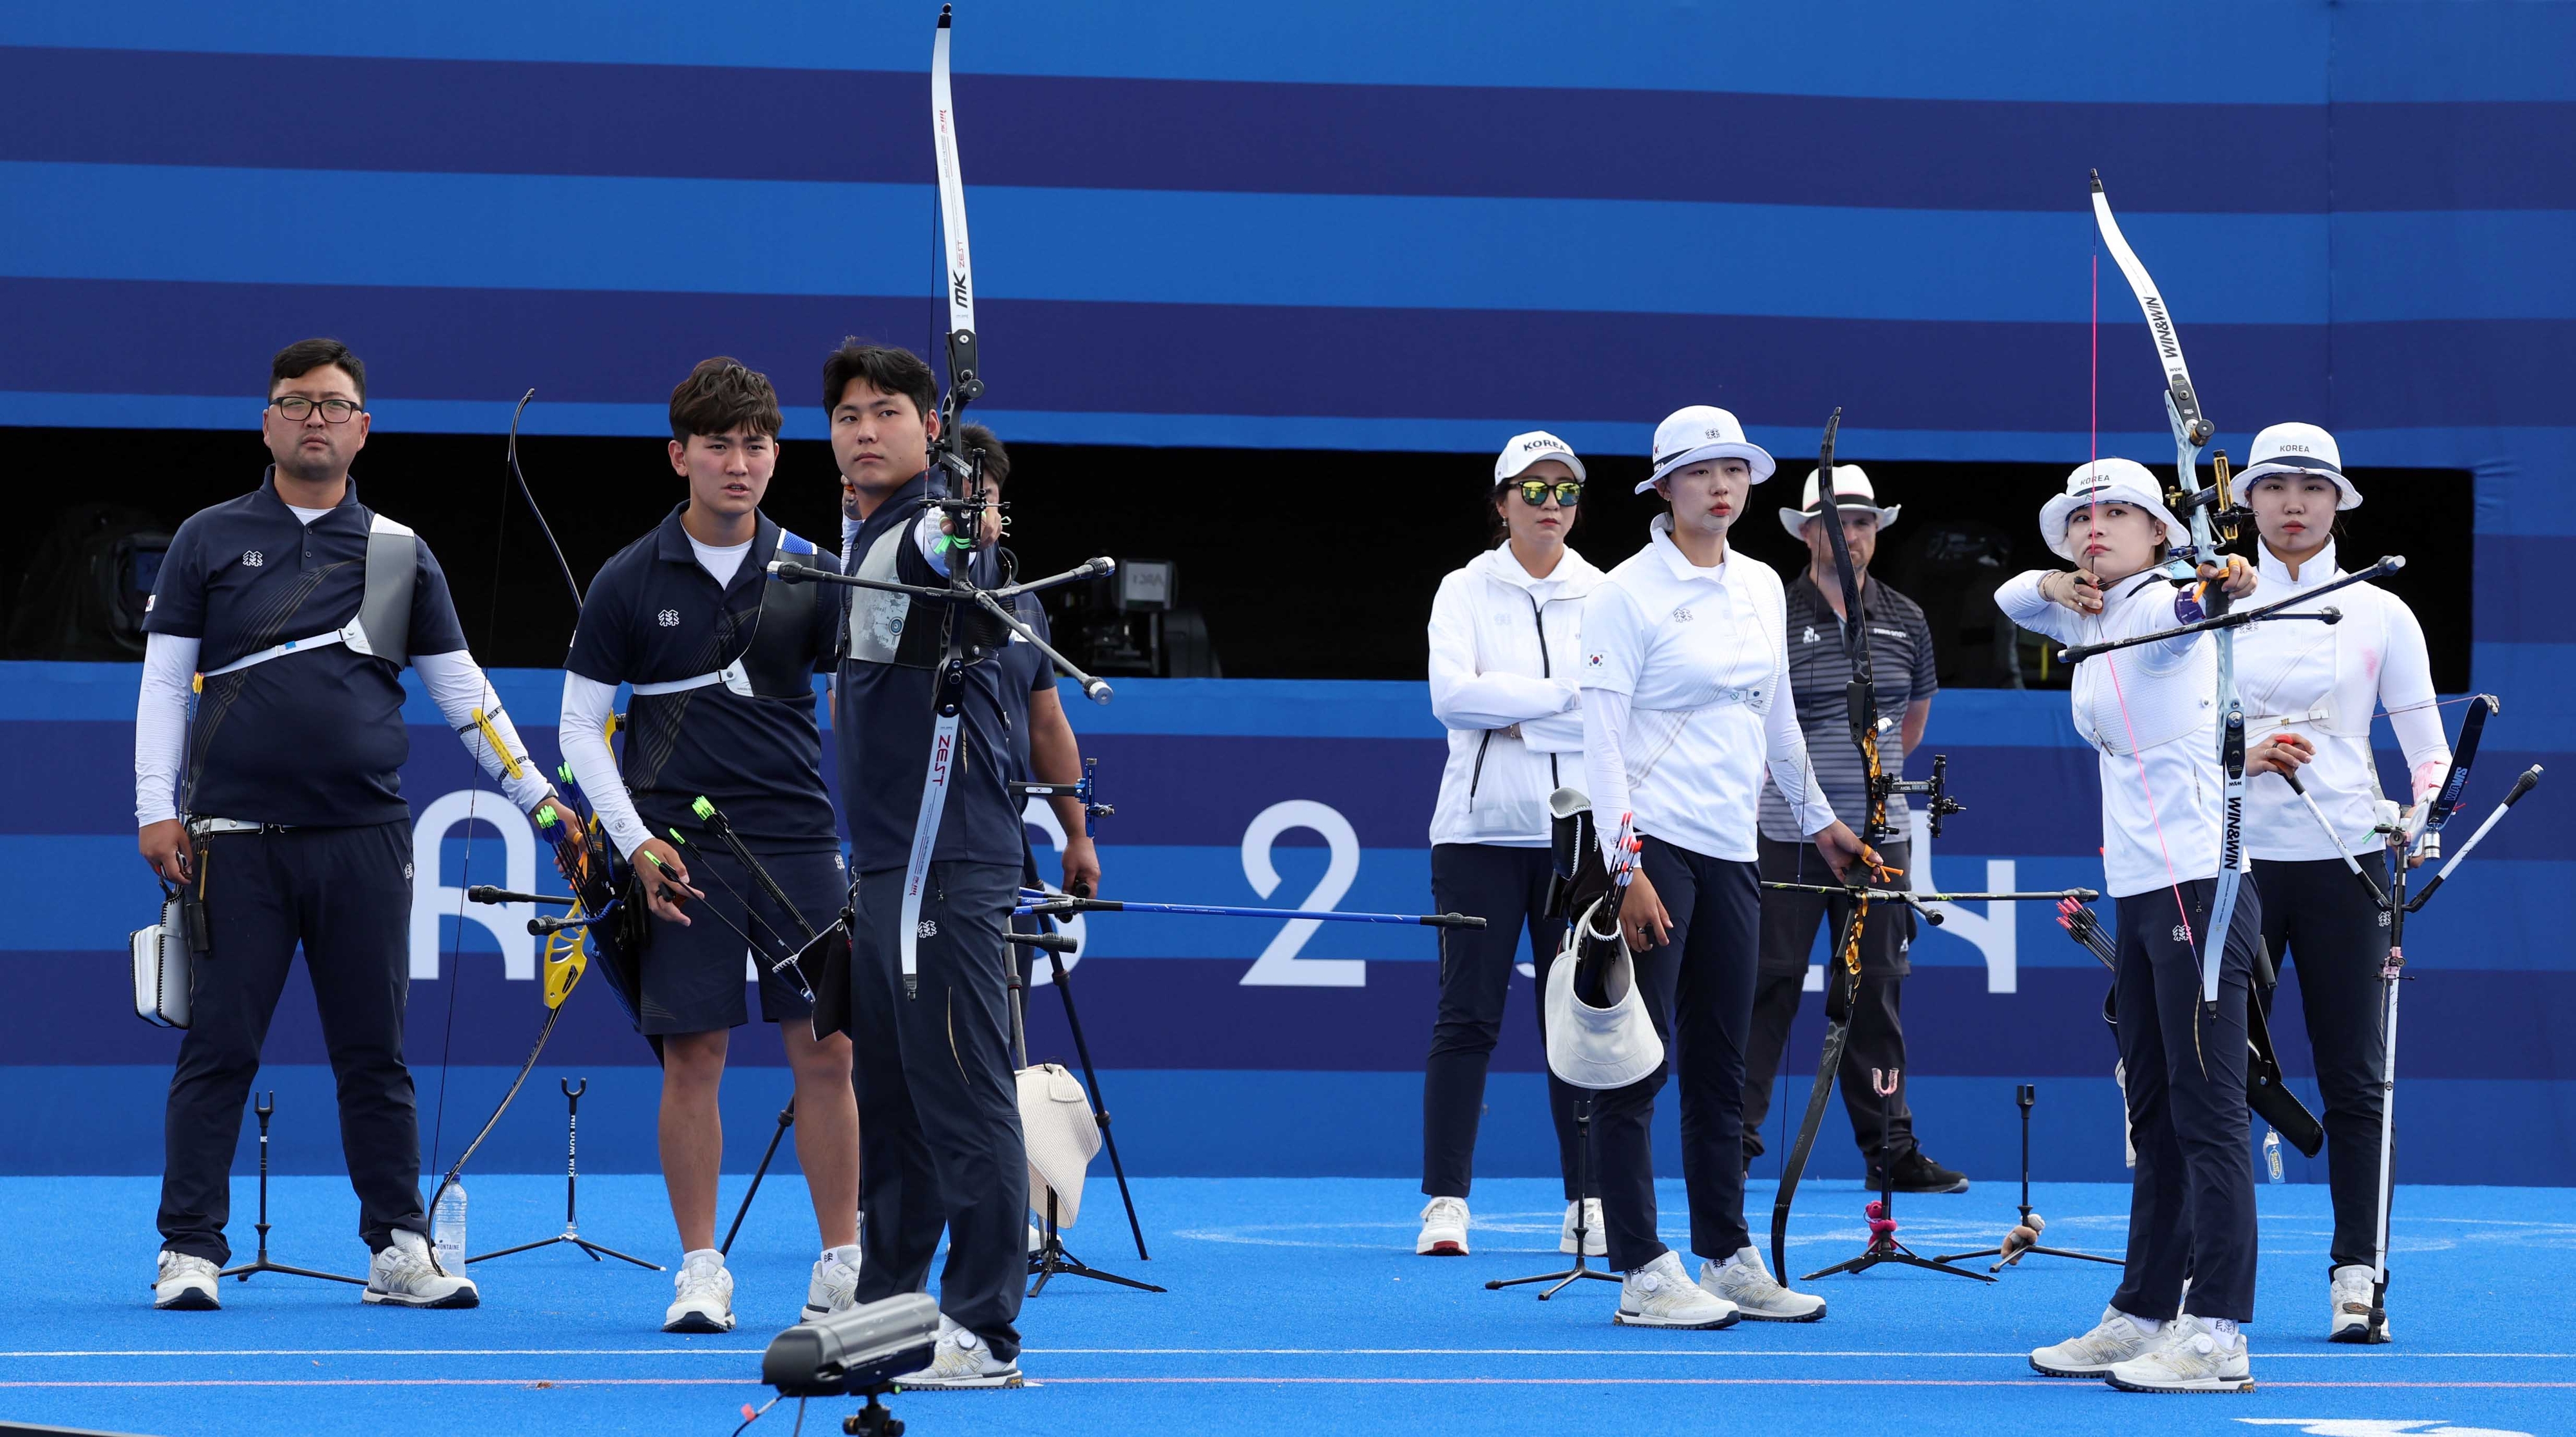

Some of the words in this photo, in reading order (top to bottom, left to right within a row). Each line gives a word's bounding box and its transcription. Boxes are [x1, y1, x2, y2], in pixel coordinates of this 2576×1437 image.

[2143, 296, 2178, 358] WIN&WIN
[1524, 440, 1566, 452] KOREA
[2280, 444, 2309, 453] KOREA
[2080, 475, 2110, 486] KOREA
[933, 734, 951, 786] ZEST
[2445, 766, 2468, 801] WIAWIS
[2224, 797, 2241, 870] WIN&WIN
